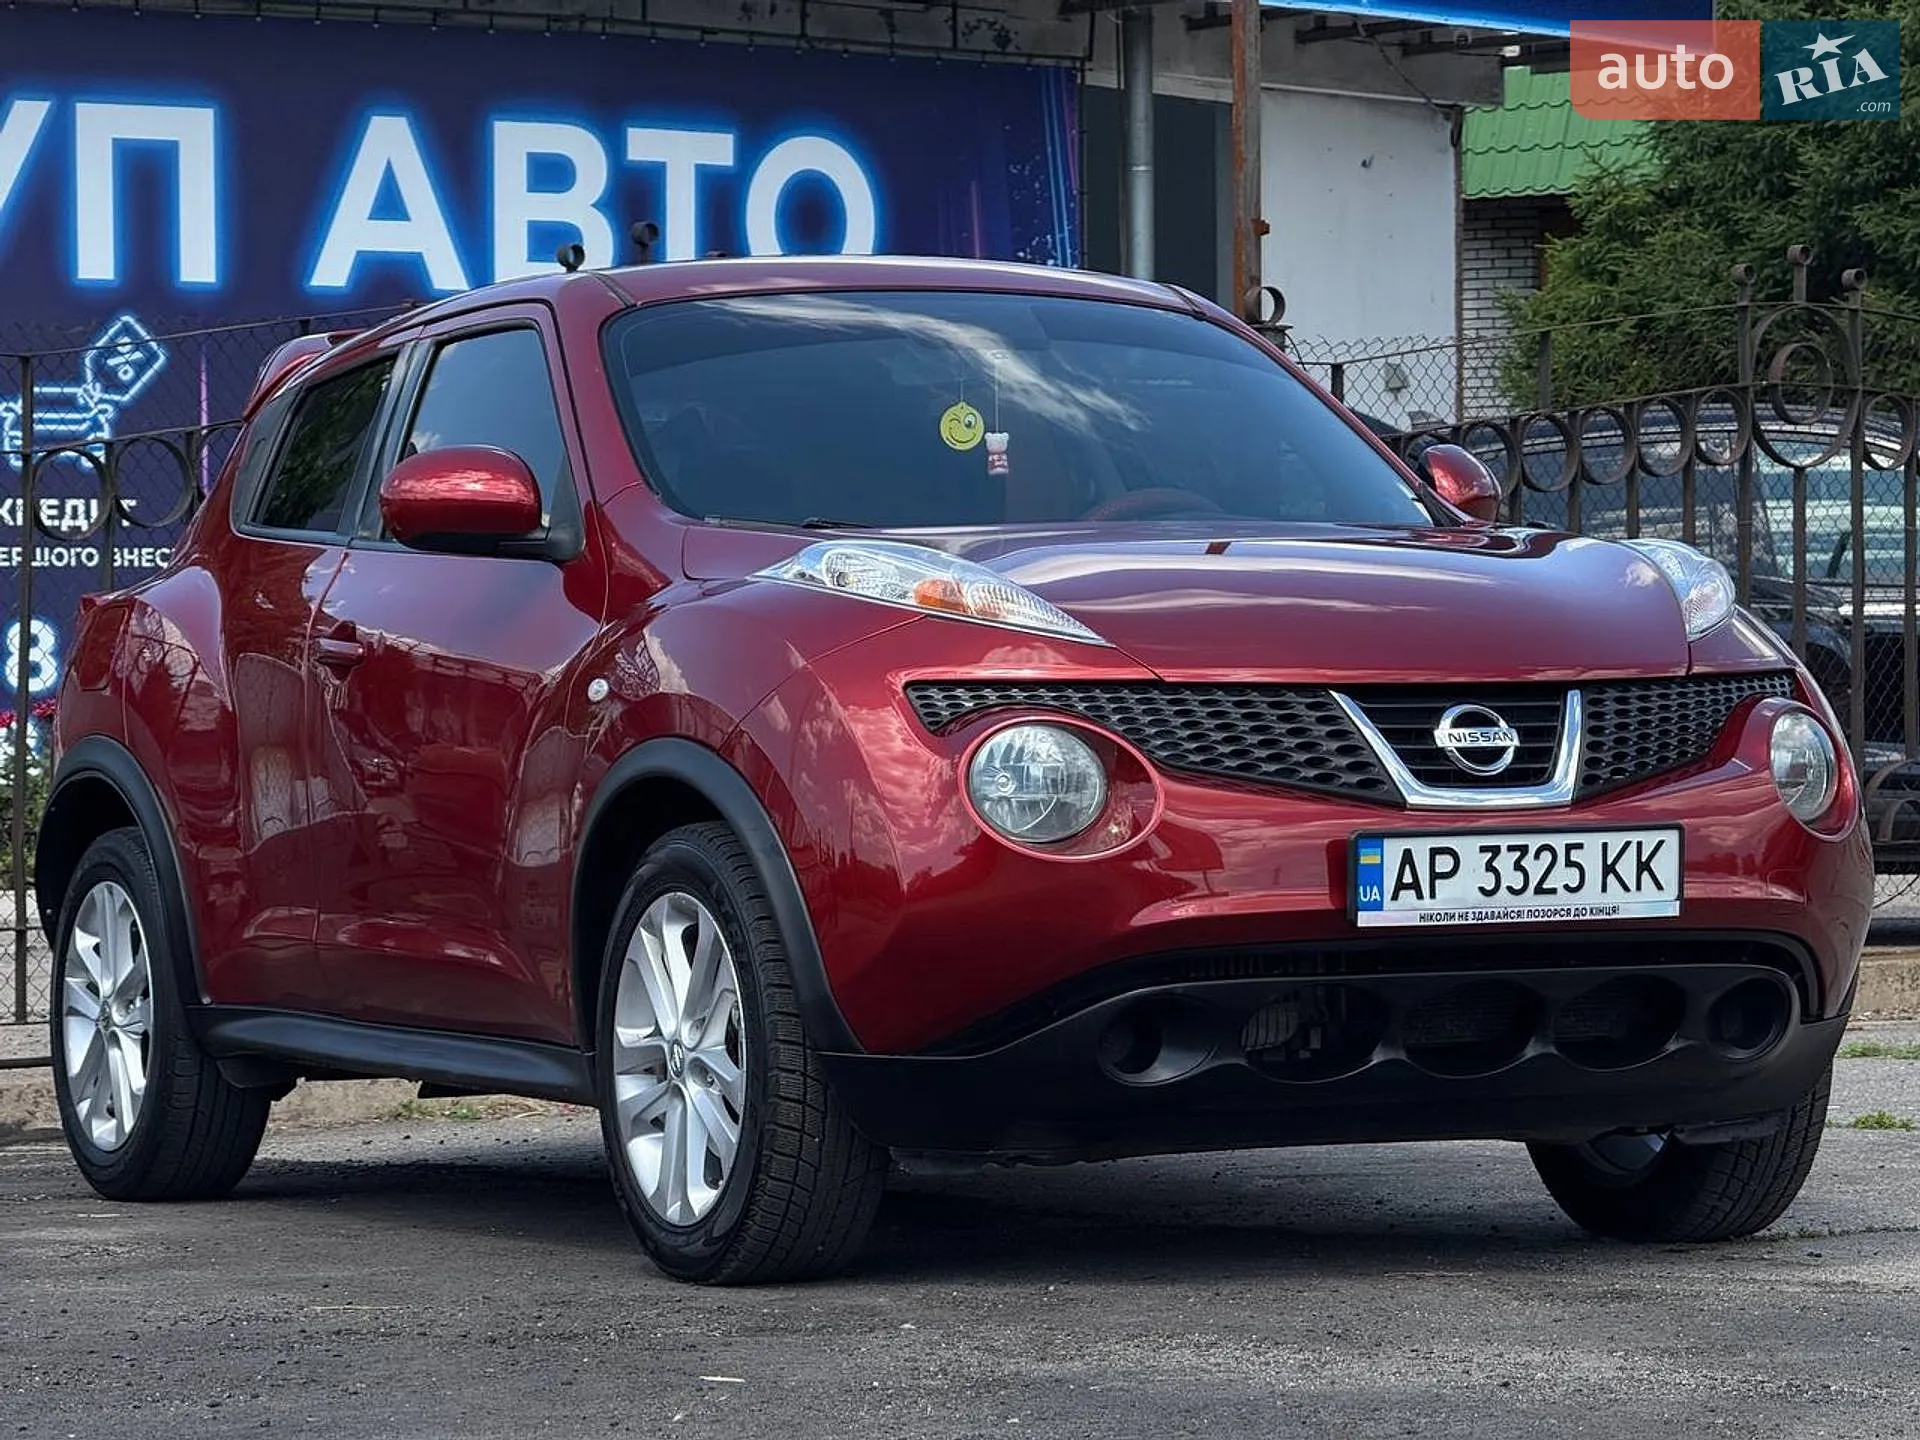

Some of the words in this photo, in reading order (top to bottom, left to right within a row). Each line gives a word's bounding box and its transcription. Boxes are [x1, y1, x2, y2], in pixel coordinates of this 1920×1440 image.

[310, 116, 876, 291] АВТО
[1447, 731, 1515, 744] NISSAN
[1391, 846, 1461, 901] AP
[1478, 842, 1586, 898] 3325
[1601, 839, 1666, 894] KK
[1360, 885, 1381, 902] UA
[1419, 911, 1456, 923] НІКОЛИ
[1457, 910, 1470, 922] НЕ
[1572, 907, 1587, 918] ДО
